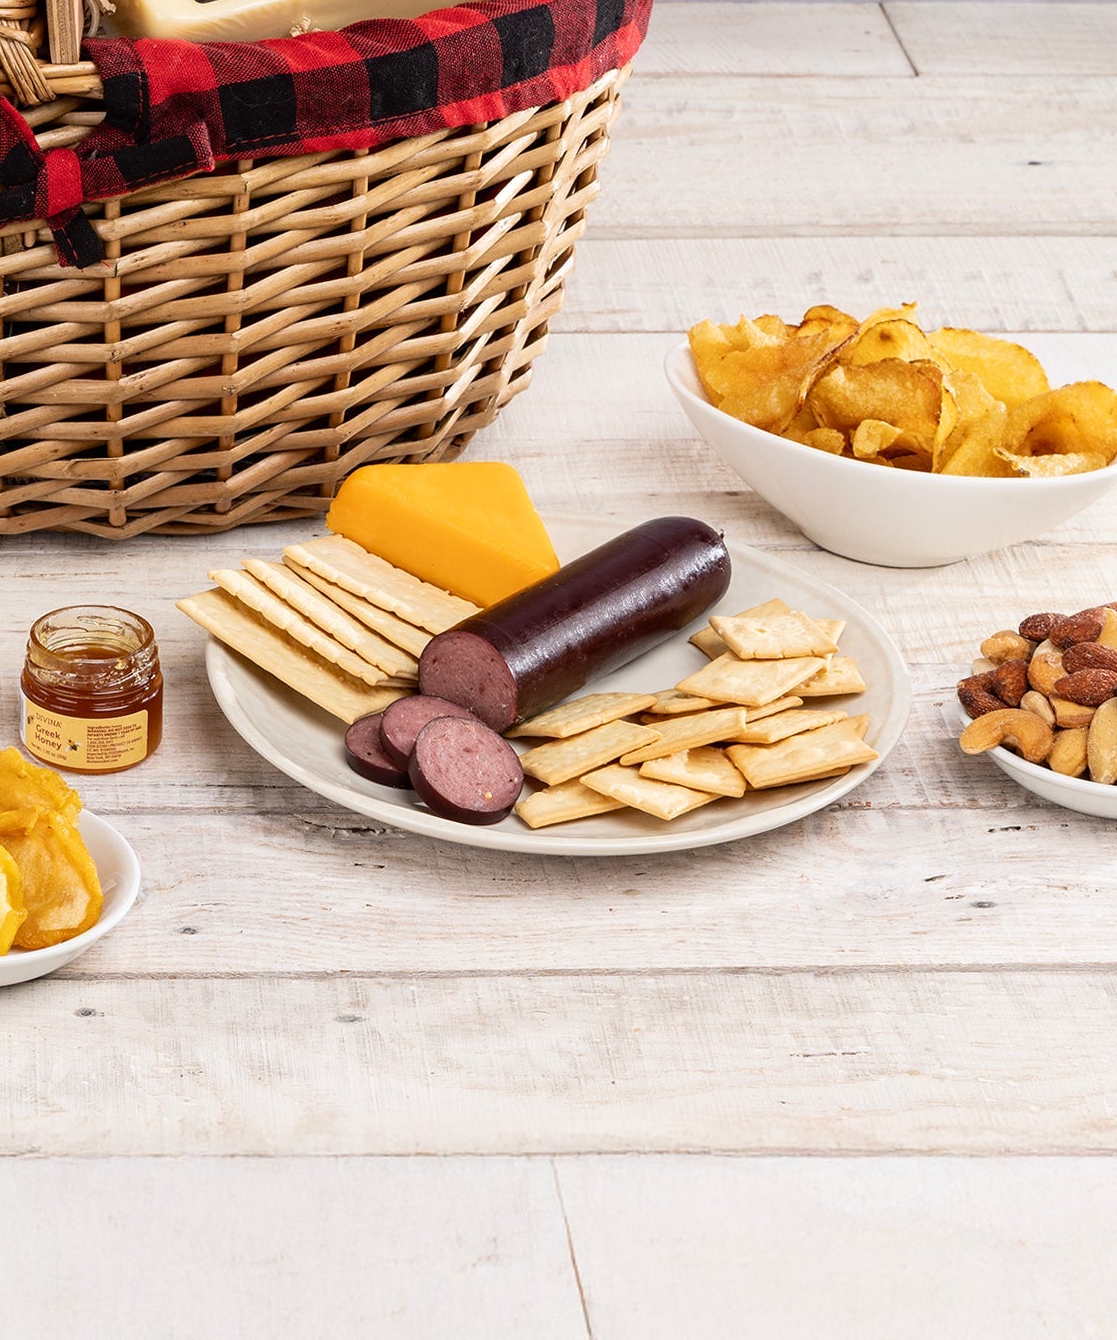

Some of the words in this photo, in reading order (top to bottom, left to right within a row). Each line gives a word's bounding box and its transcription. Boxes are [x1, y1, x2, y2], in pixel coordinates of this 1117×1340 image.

[35, 712, 62, 728] DIVINA
[35, 724, 61, 740] Greek
[34, 731, 63, 751] Honey
